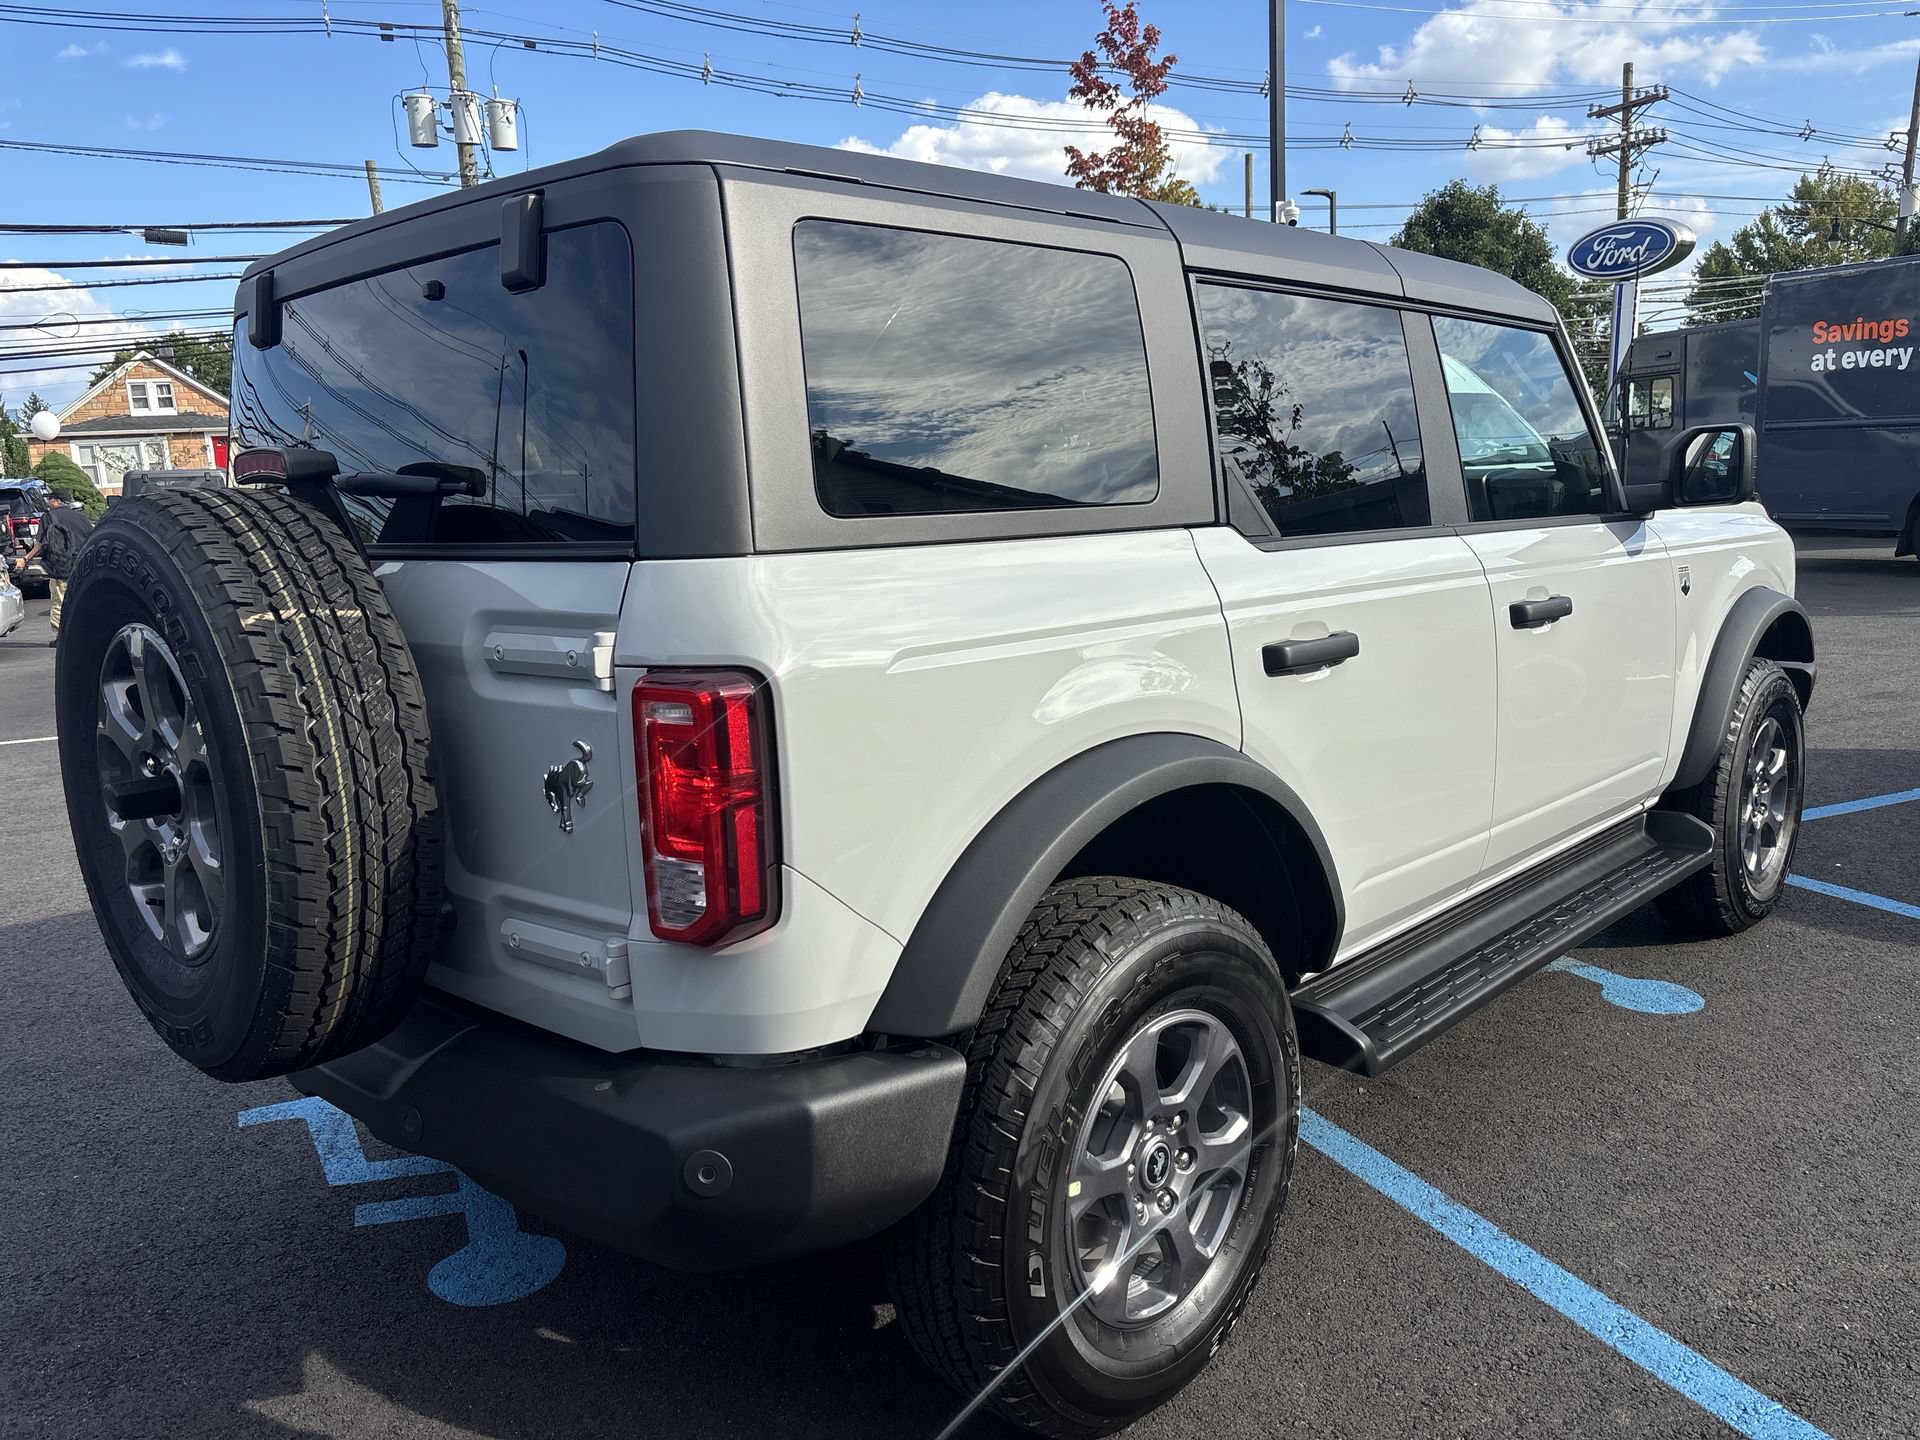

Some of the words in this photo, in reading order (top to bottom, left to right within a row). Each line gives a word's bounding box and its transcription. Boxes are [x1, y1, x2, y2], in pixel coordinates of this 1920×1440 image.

[1587, 231, 1652, 269] Ford
[1812, 317, 1909, 344] Savings
[1811, 348, 1836, 371] at
[1841, 347, 1914, 371] every
[64, 540, 208, 683] IDGESTONE
